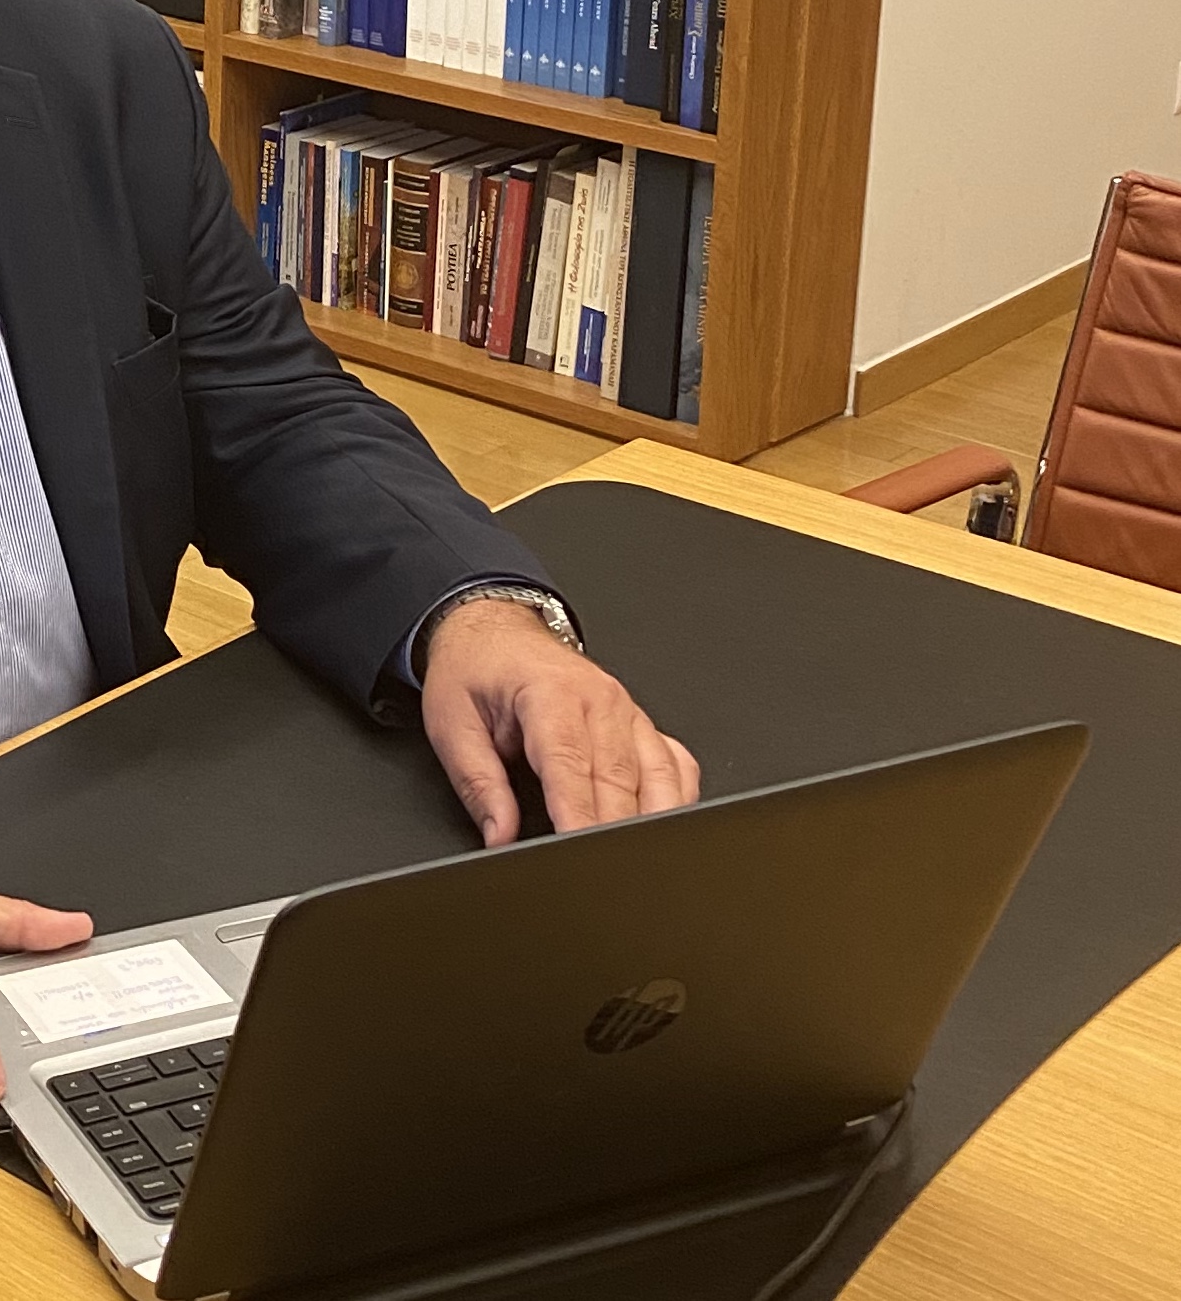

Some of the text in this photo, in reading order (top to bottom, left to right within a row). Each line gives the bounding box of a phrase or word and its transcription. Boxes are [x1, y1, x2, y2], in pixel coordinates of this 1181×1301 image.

[648, 21, 659, 50] Ahead
[260, 139, 271, 205] Management
[620, 225, 631, 253] ΑΘΗΝΑ
[568, 283, 577, 293] Η
